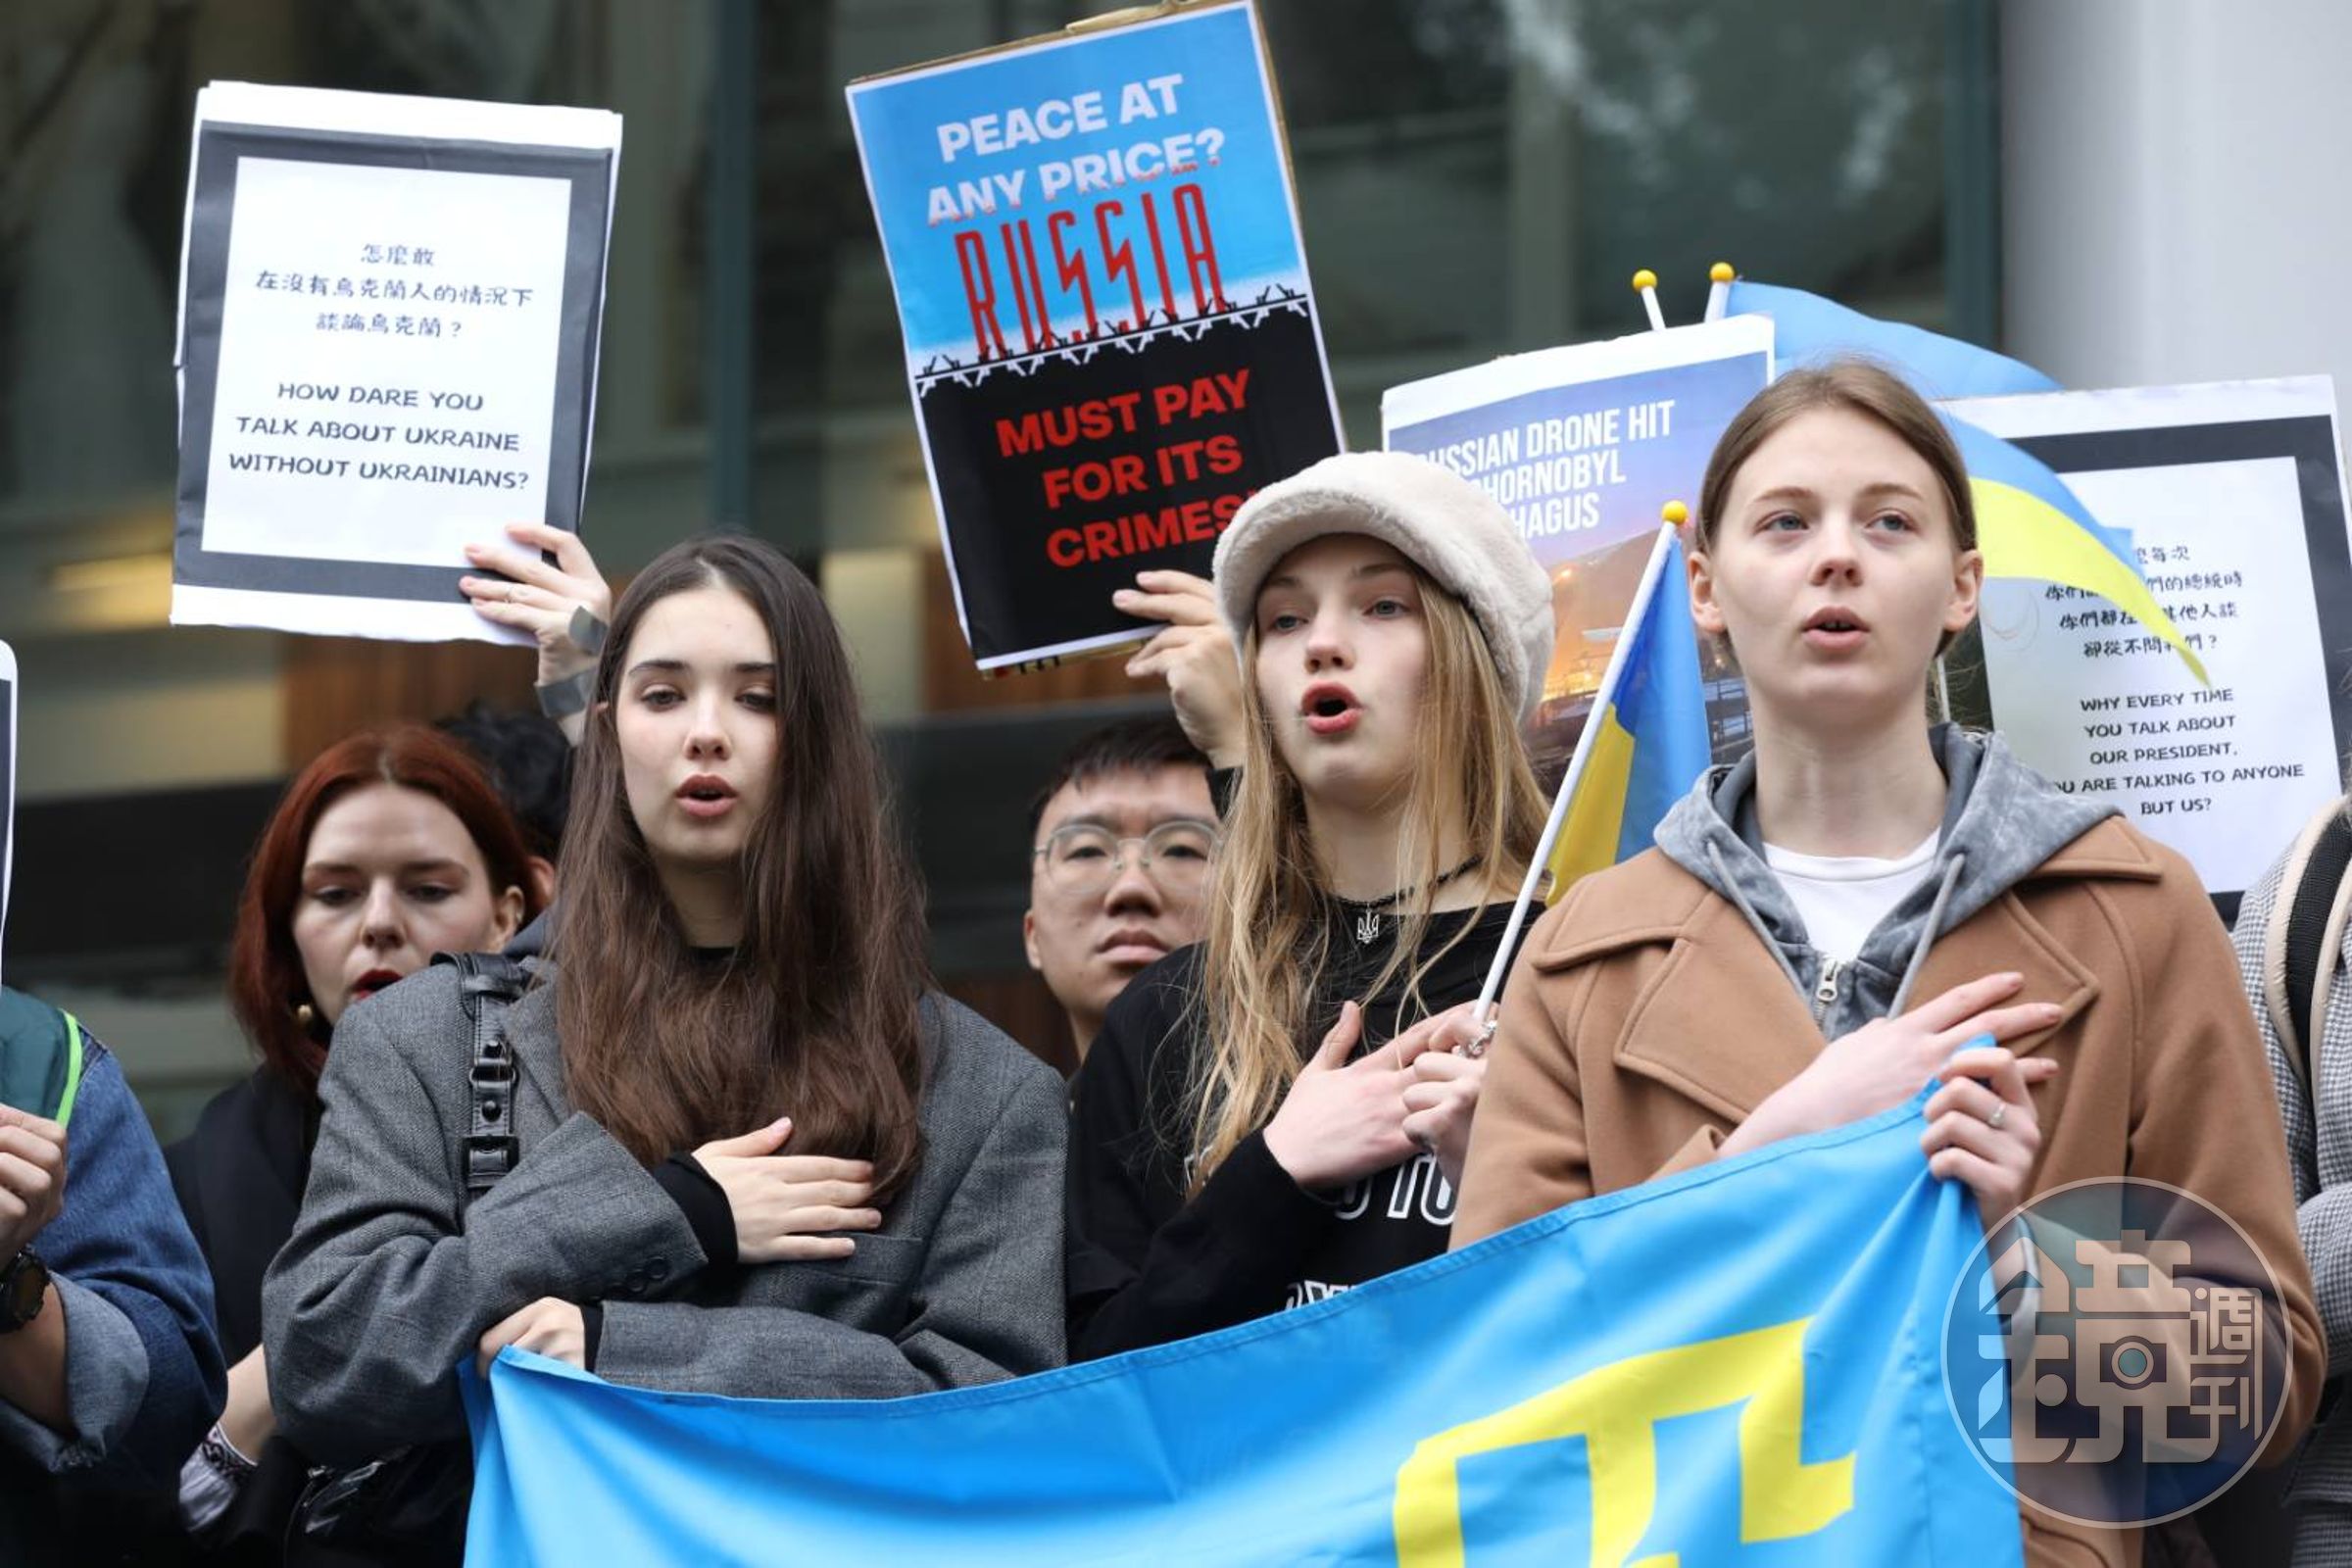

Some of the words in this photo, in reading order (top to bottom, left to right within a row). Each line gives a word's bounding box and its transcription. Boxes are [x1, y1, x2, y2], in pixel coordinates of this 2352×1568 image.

[937, 92, 1107, 162] PEACE
[1119, 74, 1183, 124] AT
[927, 170, 1025, 226] ANY
[1038, 127, 1225, 201] PRICE?
[361, 244, 434, 266] 怎麼敢
[954, 183, 1227, 361] RUSSIA
[277, 382, 339, 401] HOW
[348, 386, 418, 407] DARE
[429, 392, 484, 412] YOU
[996, 391, 1141, 457] MUST
[1153, 368, 1250, 425] PAY
[236, 416, 298, 435] TALK
[307, 420, 396, 443] ABOUT
[406, 427, 519, 452] UKRAINE
[1420, 427, 1519, 476] SSIAN
[1526, 408, 1620, 458] DRONE
[1628, 399, 1676, 441] HIT
[228, 453, 350, 477] WITHOUT
[360, 463, 529, 490] UKRAINIANS?
[1042, 455, 1149, 509] FOR
[1155, 434, 1244, 485] ITS
[1473, 450, 1626, 505] HORNOBYL
[1046, 488, 1256, 568] CRIMES
[1511, 492, 1599, 539] HAGUS
[2080, 696, 2120, 711] WHY
[2127, 693, 2184, 709] EVERY
[2191, 689, 2233, 704] TIME
[2084, 722, 2122, 738] YOU
[2129, 719, 2171, 734] TALK
[2176, 715, 2235, 732] ABOUT
[2089, 748, 2128, 764] OUR
[2082, 776, 2117, 792] ARE
[2123, 771, 2196, 789] TALKING
[2201, 769, 2225, 783] TO
[2231, 763, 2305, 781] ANYONE
[2140, 800, 2176, 815] BUT
[2181, 798, 2212, 812] US?
